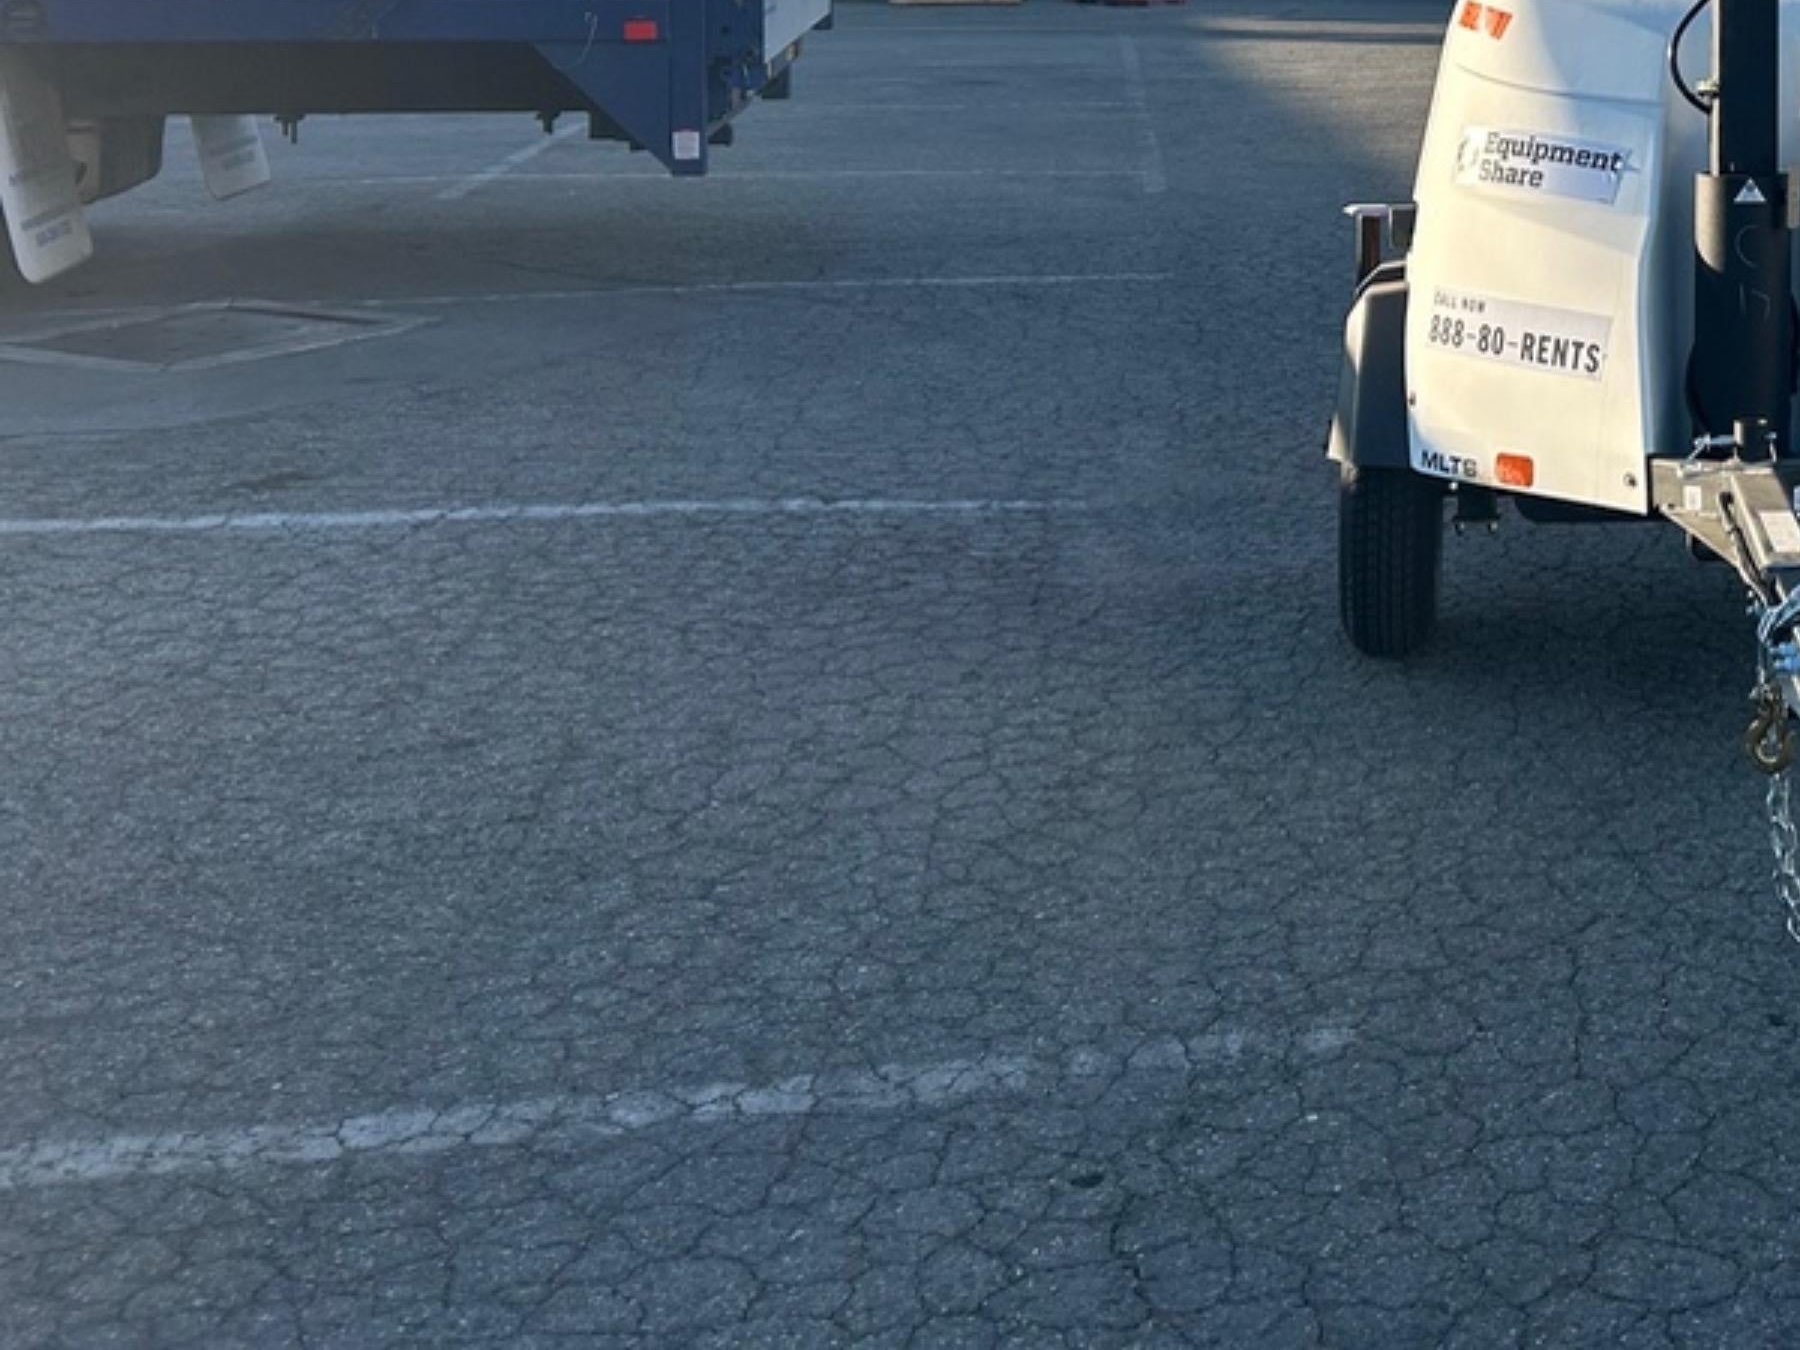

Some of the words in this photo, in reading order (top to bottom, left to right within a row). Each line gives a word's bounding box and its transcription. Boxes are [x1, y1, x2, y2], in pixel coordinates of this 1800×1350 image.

[1485, 132, 1622, 172] Equipment
[1480, 158, 1544, 188] Share
[1428, 314, 1602, 374] 888-80-RENTS
